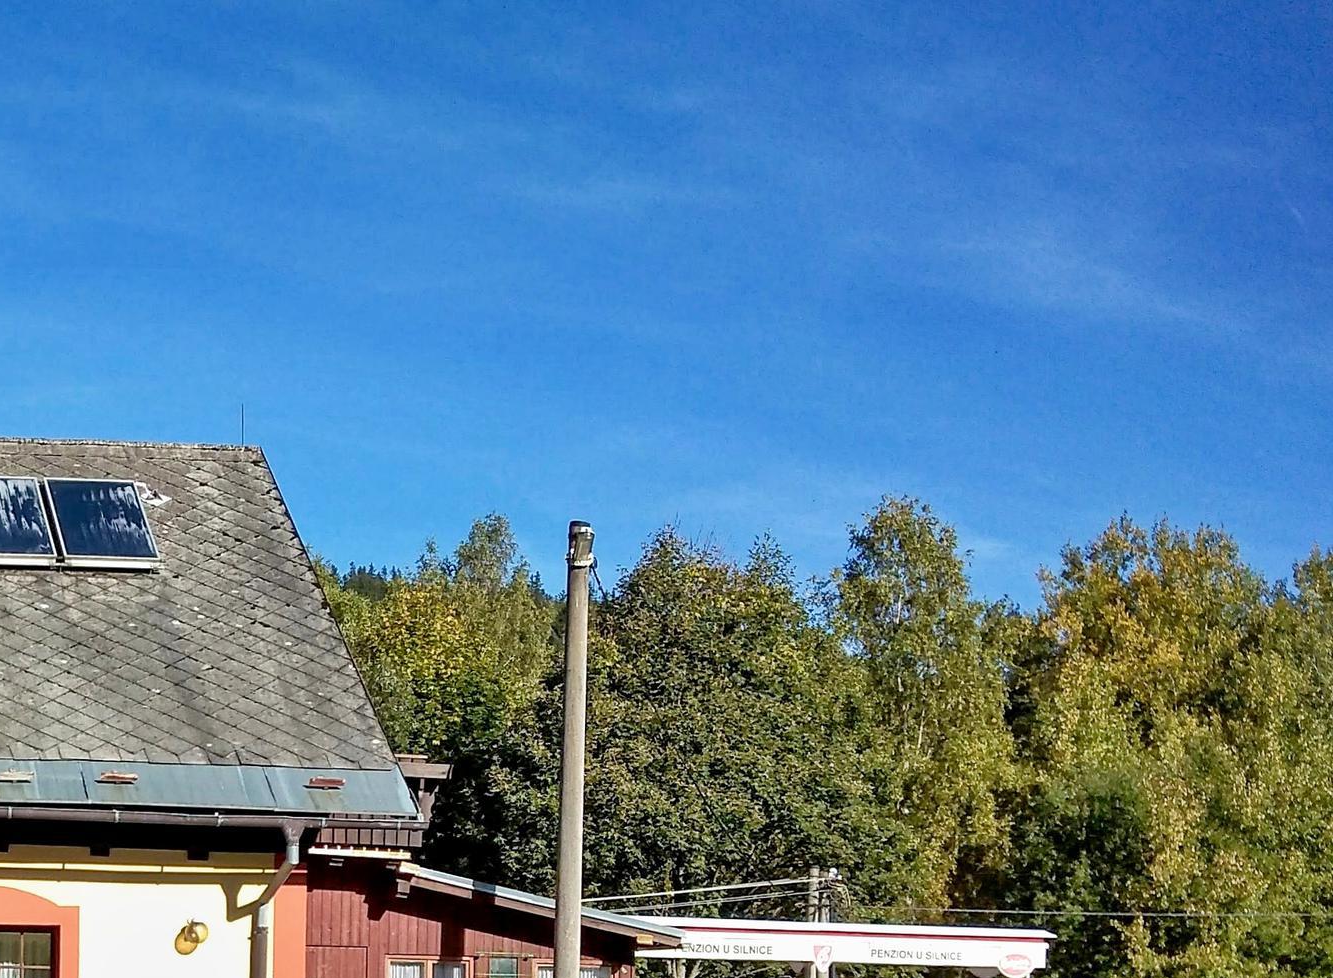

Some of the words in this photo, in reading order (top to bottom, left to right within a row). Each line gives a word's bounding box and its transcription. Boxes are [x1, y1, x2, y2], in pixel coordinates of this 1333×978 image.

[675, 943, 720, 953] ENZION
[723, 944, 730, 953] U
[733, 945, 773, 955] SILNICE
[870, 949, 913, 959] PENZION
[916, 951, 923, 960] U
[925, 951, 962, 961] SILNICE
